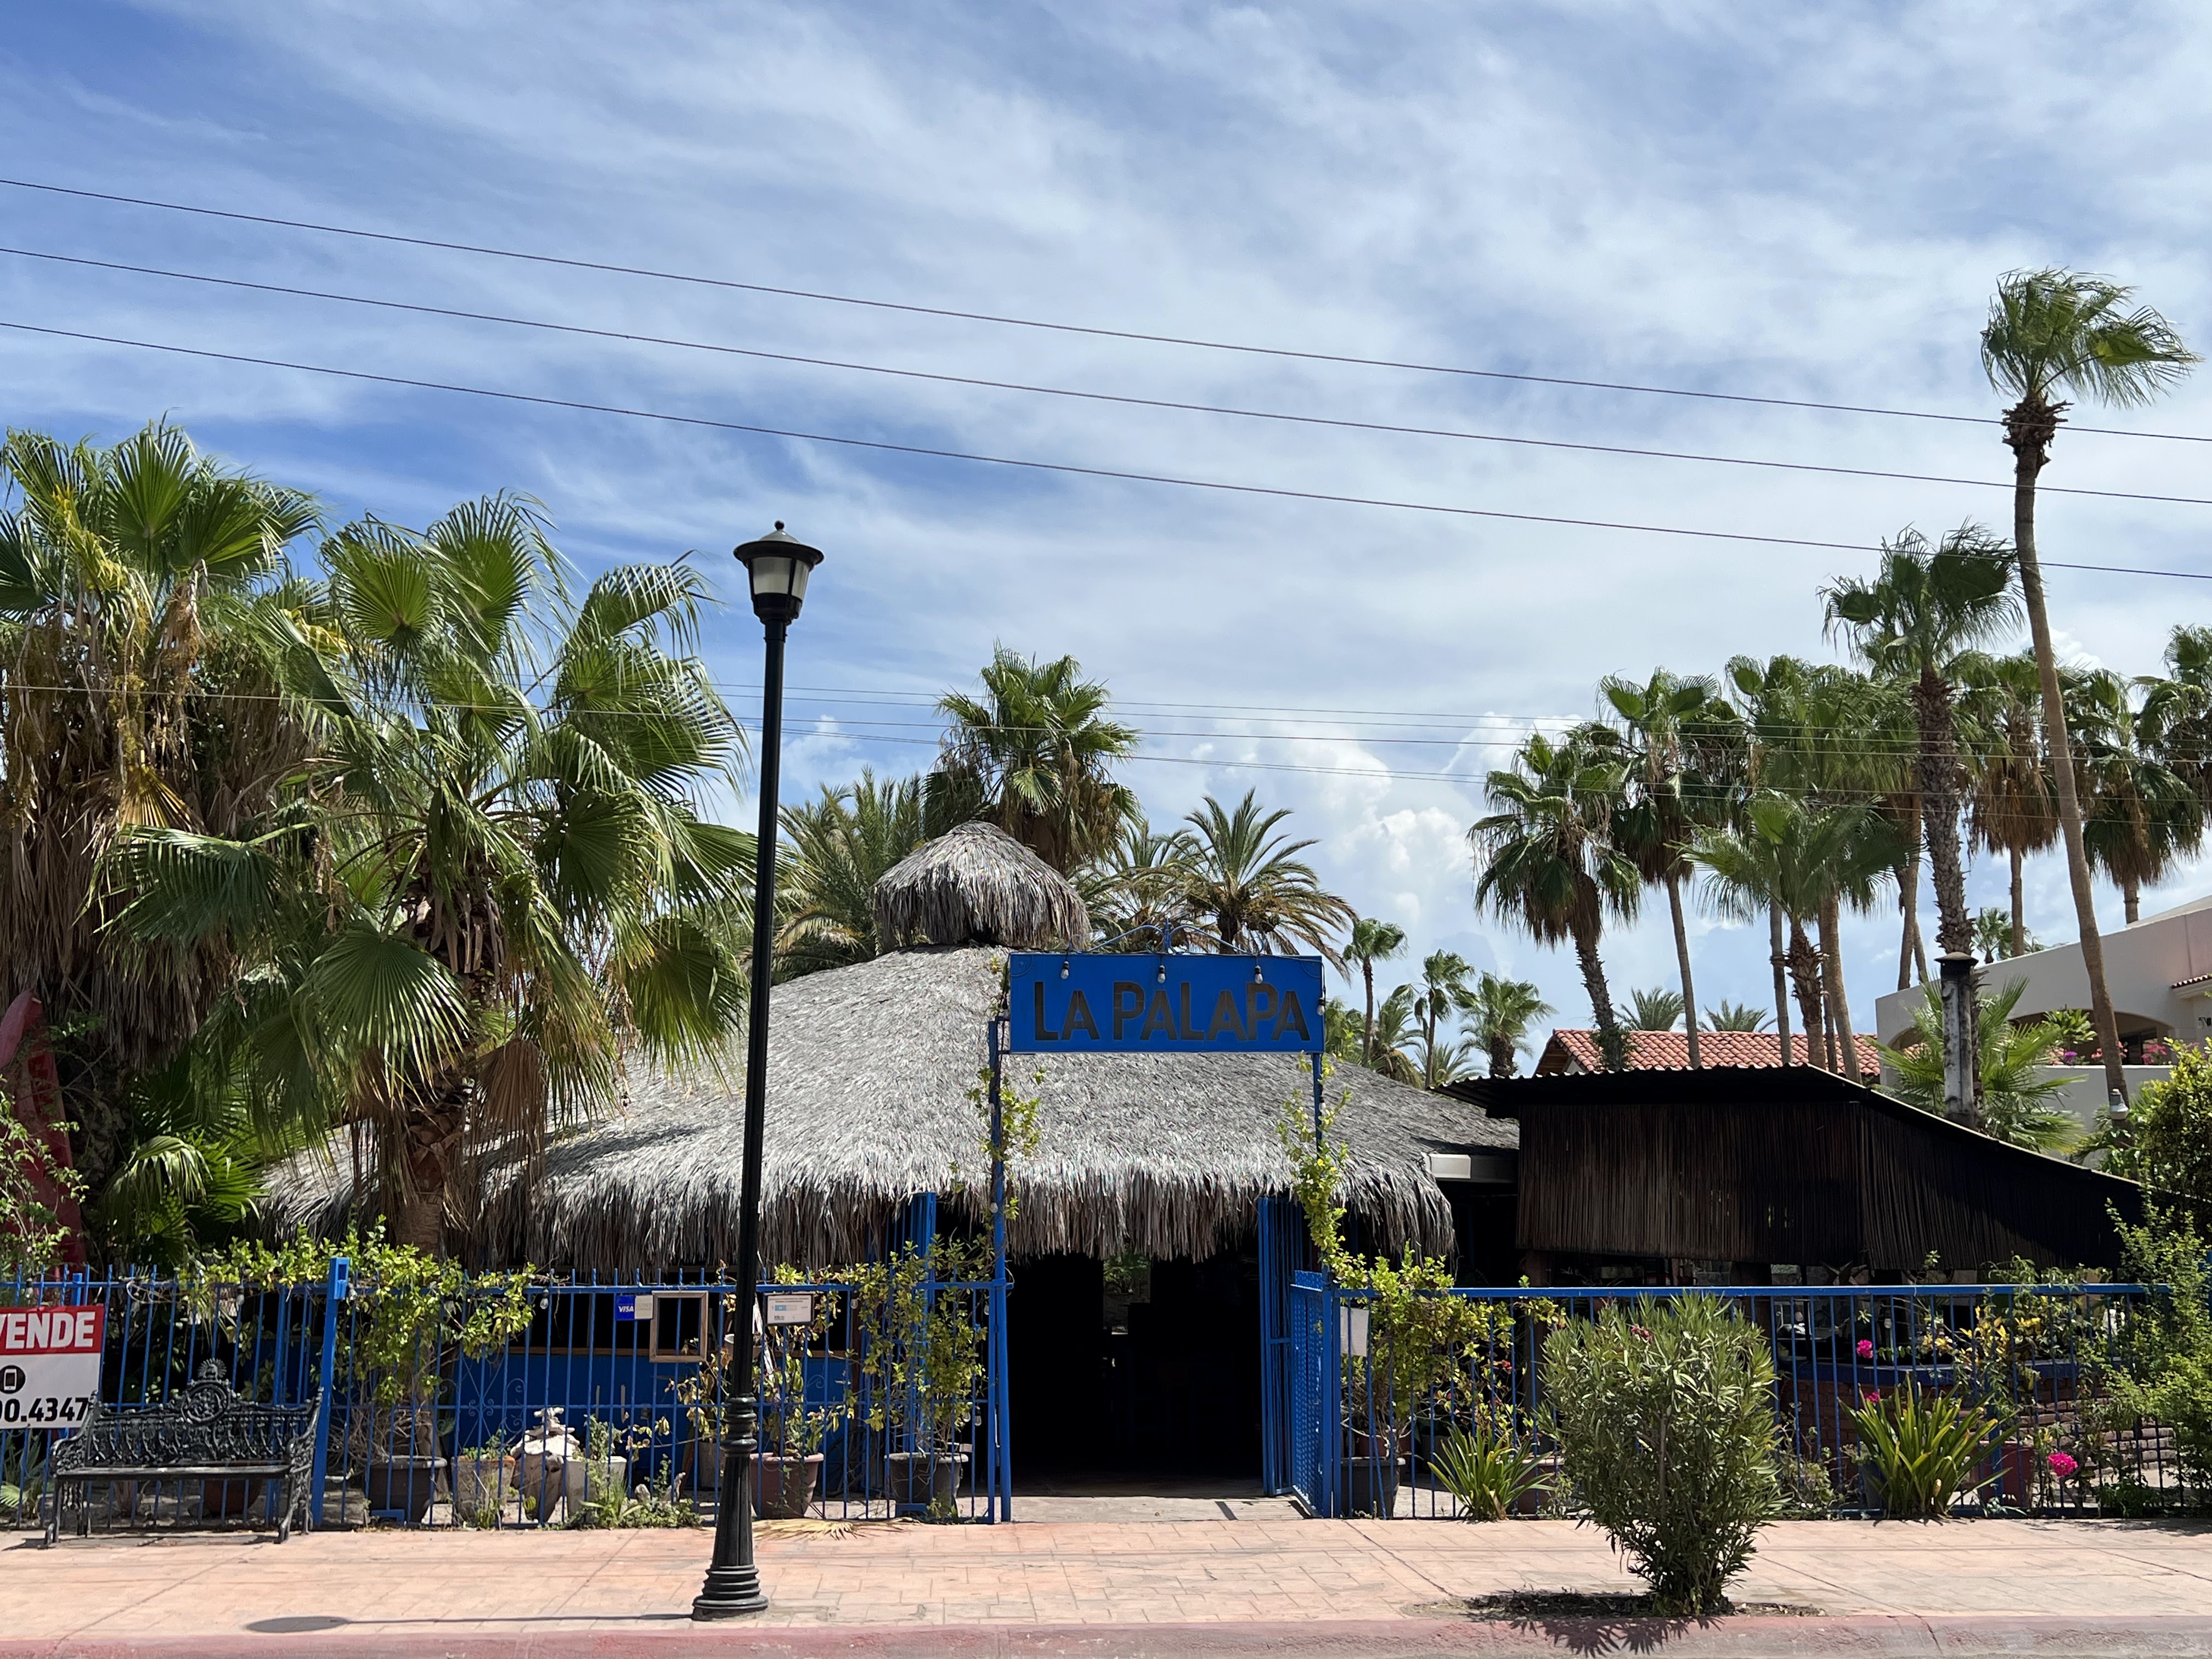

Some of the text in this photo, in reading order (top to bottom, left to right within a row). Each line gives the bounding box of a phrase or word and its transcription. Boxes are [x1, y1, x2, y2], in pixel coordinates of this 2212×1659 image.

[1034, 981, 1311, 1040] LA PALAPA
[0, 1397, 88, 1422] 0.4347
